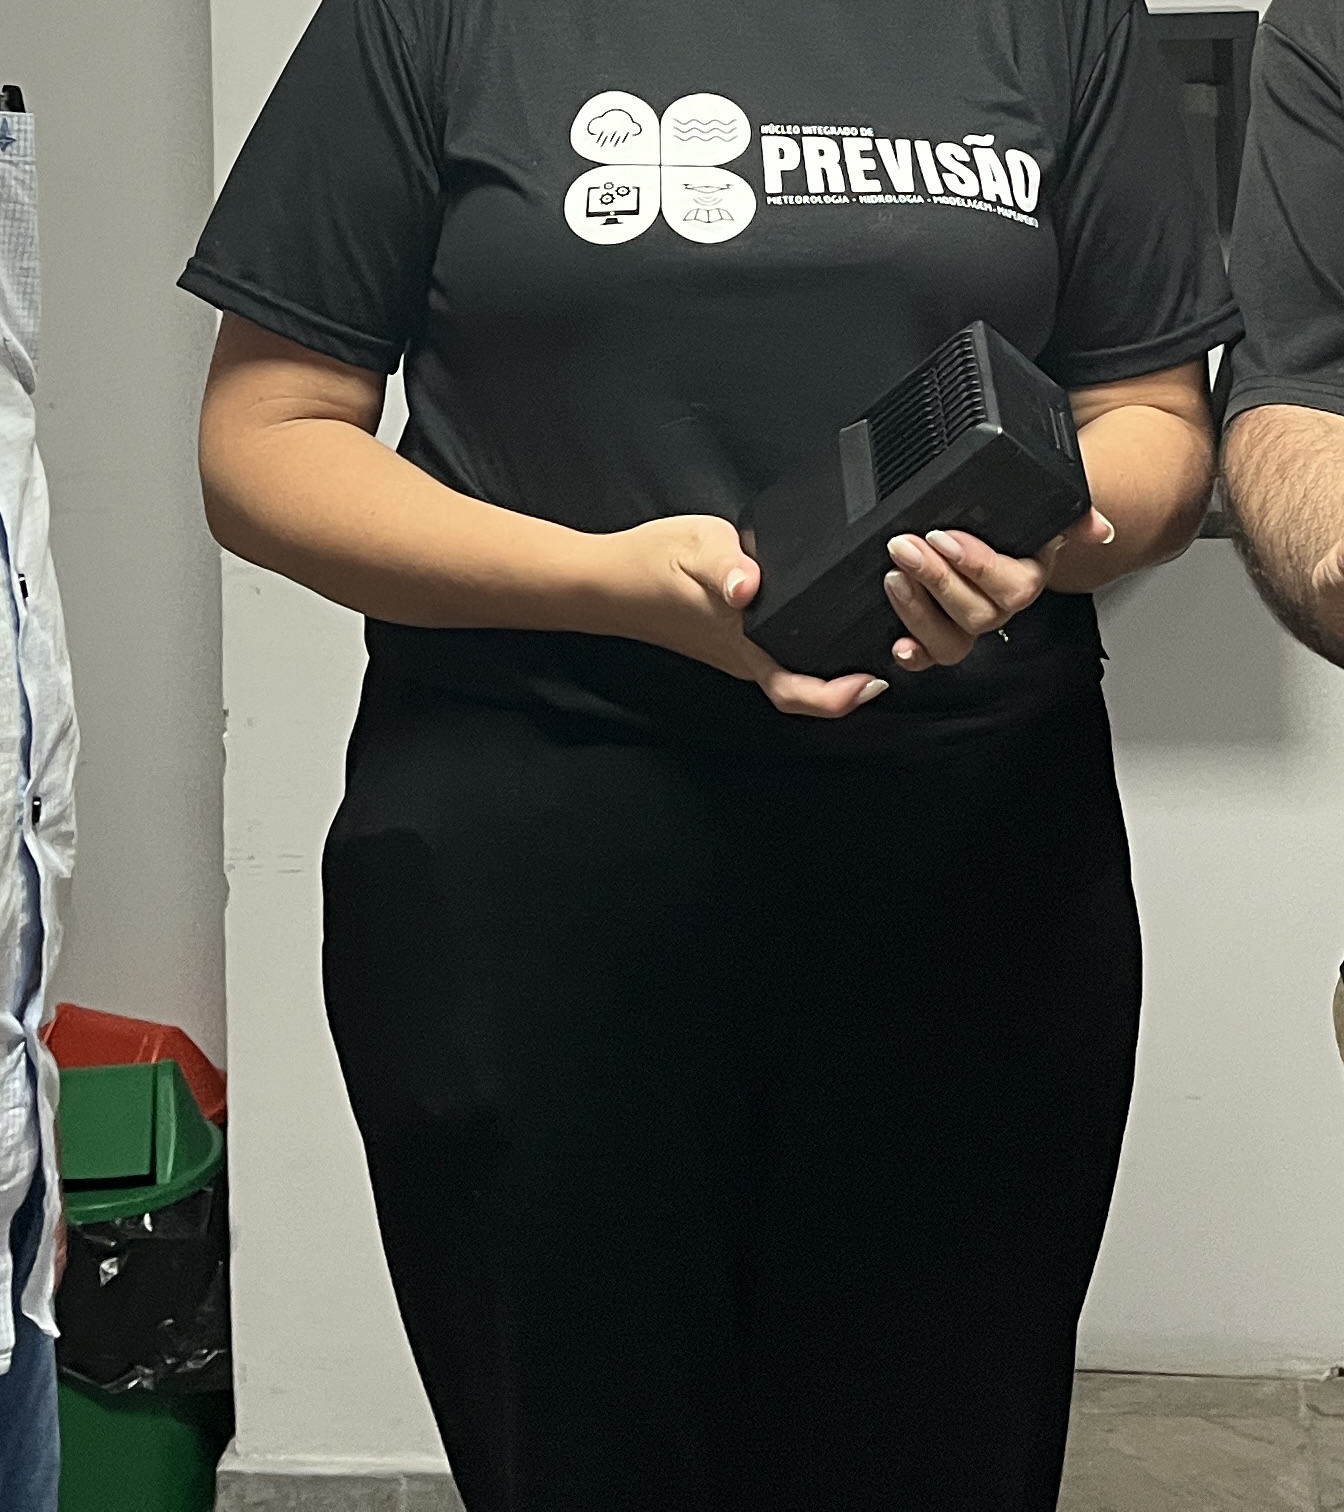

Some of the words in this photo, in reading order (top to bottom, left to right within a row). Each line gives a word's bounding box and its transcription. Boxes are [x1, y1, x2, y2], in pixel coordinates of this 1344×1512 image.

[760, 123, 801, 135] NÚCLEO
[802, 125, 859, 136] INTEGRADO
[859, 127, 875, 137] DE
[760, 134, 1041, 213] PREVISÃO
[766, 195, 850, 205] METEOROLOGIA
[858, 194, 925, 204] HIDROLOGIA
